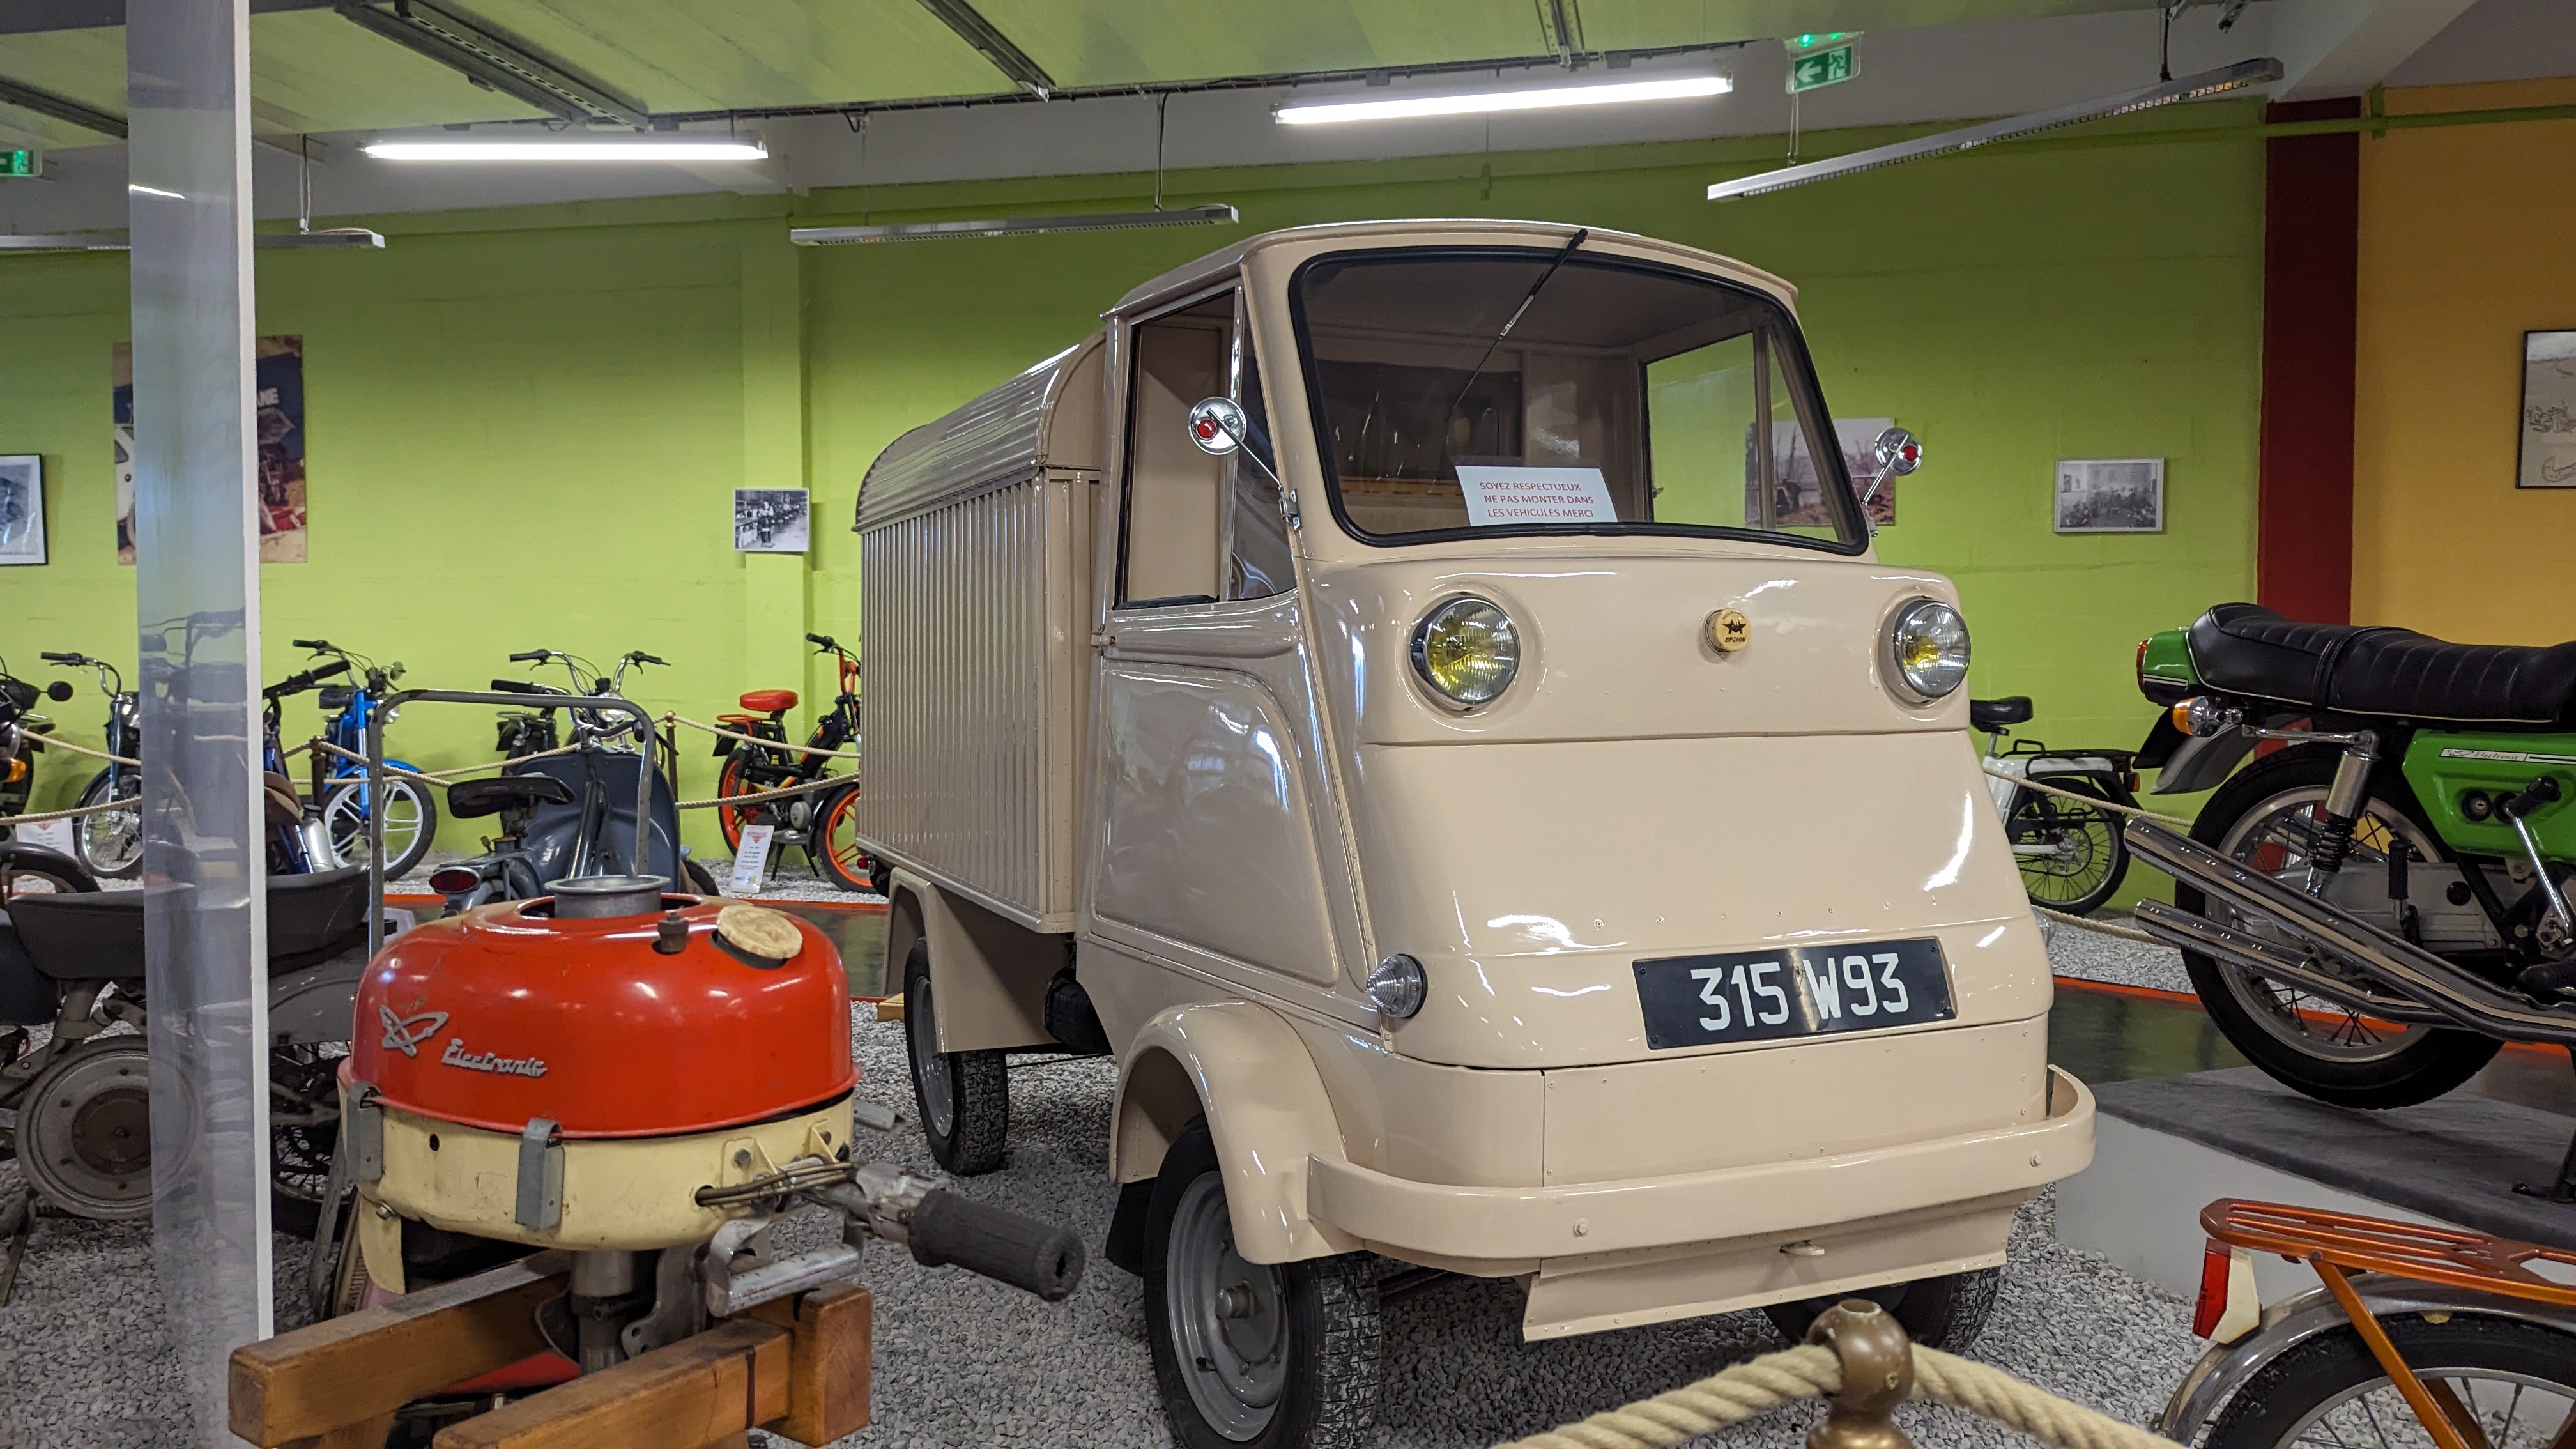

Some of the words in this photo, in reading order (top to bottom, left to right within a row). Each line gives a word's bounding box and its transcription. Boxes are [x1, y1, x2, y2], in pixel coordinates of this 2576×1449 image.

[1513, 482, 1581, 491] RESPECTUEUX
[1501, 495, 1519, 503] PAS
[1487, 509, 1505, 517] LES
[1506, 509, 1560, 517] VEHICULES
[1562, 509, 1593, 518] MERCI
[2474, 751, 2519, 760] Electronic
[1690, 962, 1789, 1031] 315
